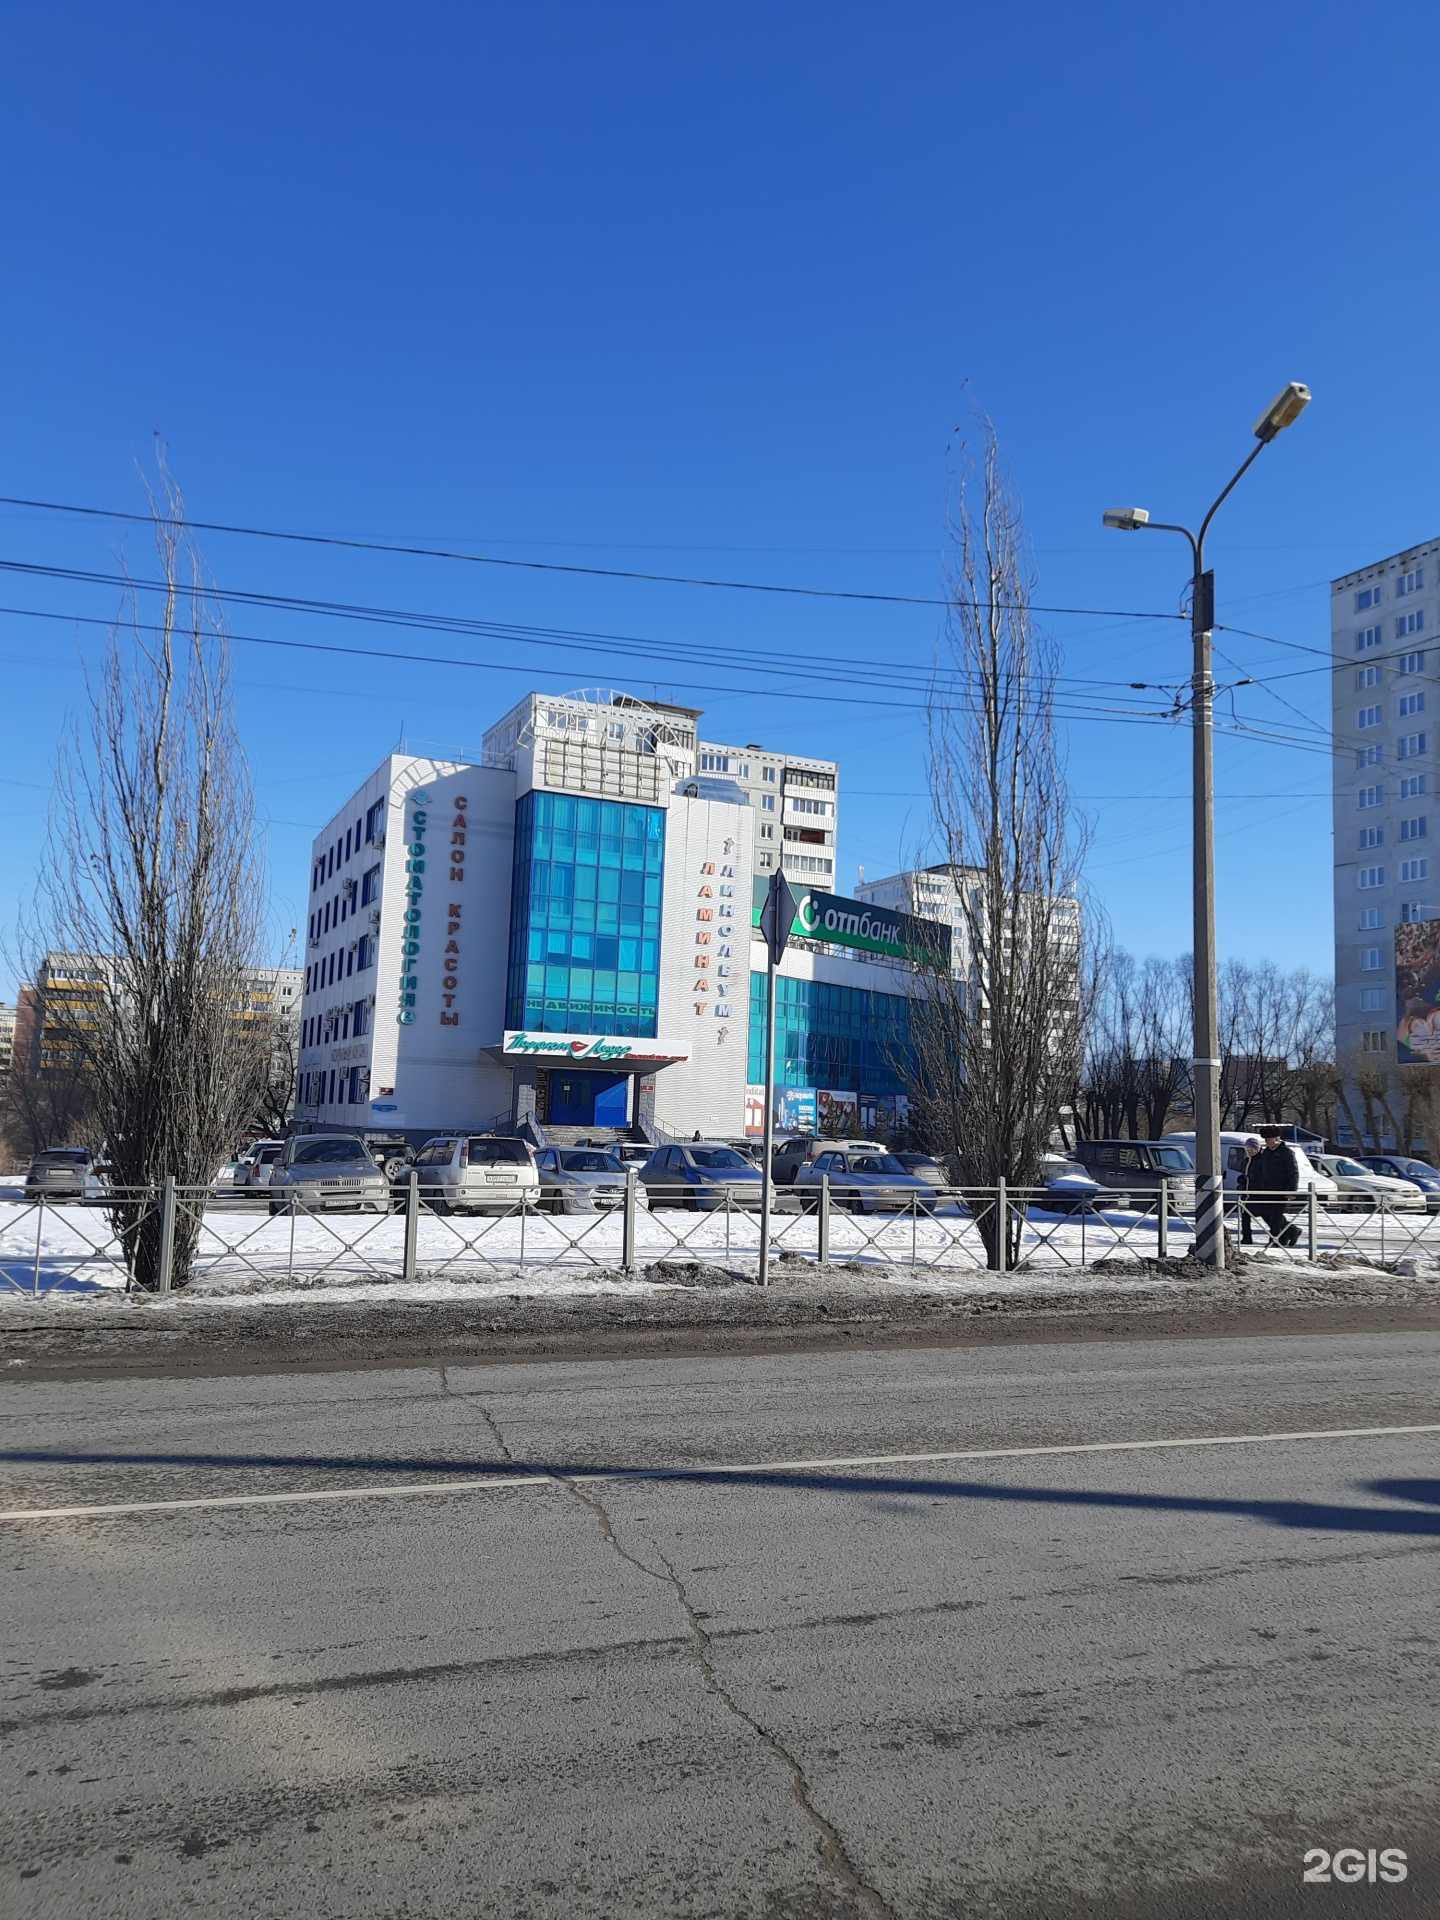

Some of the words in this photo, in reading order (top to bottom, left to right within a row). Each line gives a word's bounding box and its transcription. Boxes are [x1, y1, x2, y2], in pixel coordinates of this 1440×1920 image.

[450, 796, 468, 882] САЛОН
[398, 811, 427, 1009] СТОМАТОЛОГИЯ
[439, 903, 461, 1026] КРАСОТЫ
[693, 862, 716, 1016] ЛАМИНАТ
[714, 864, 735, 1018] ЛИНОЛЕУМ
[526, 999, 655, 1017] НЕДВИЖИМОСТЬ
